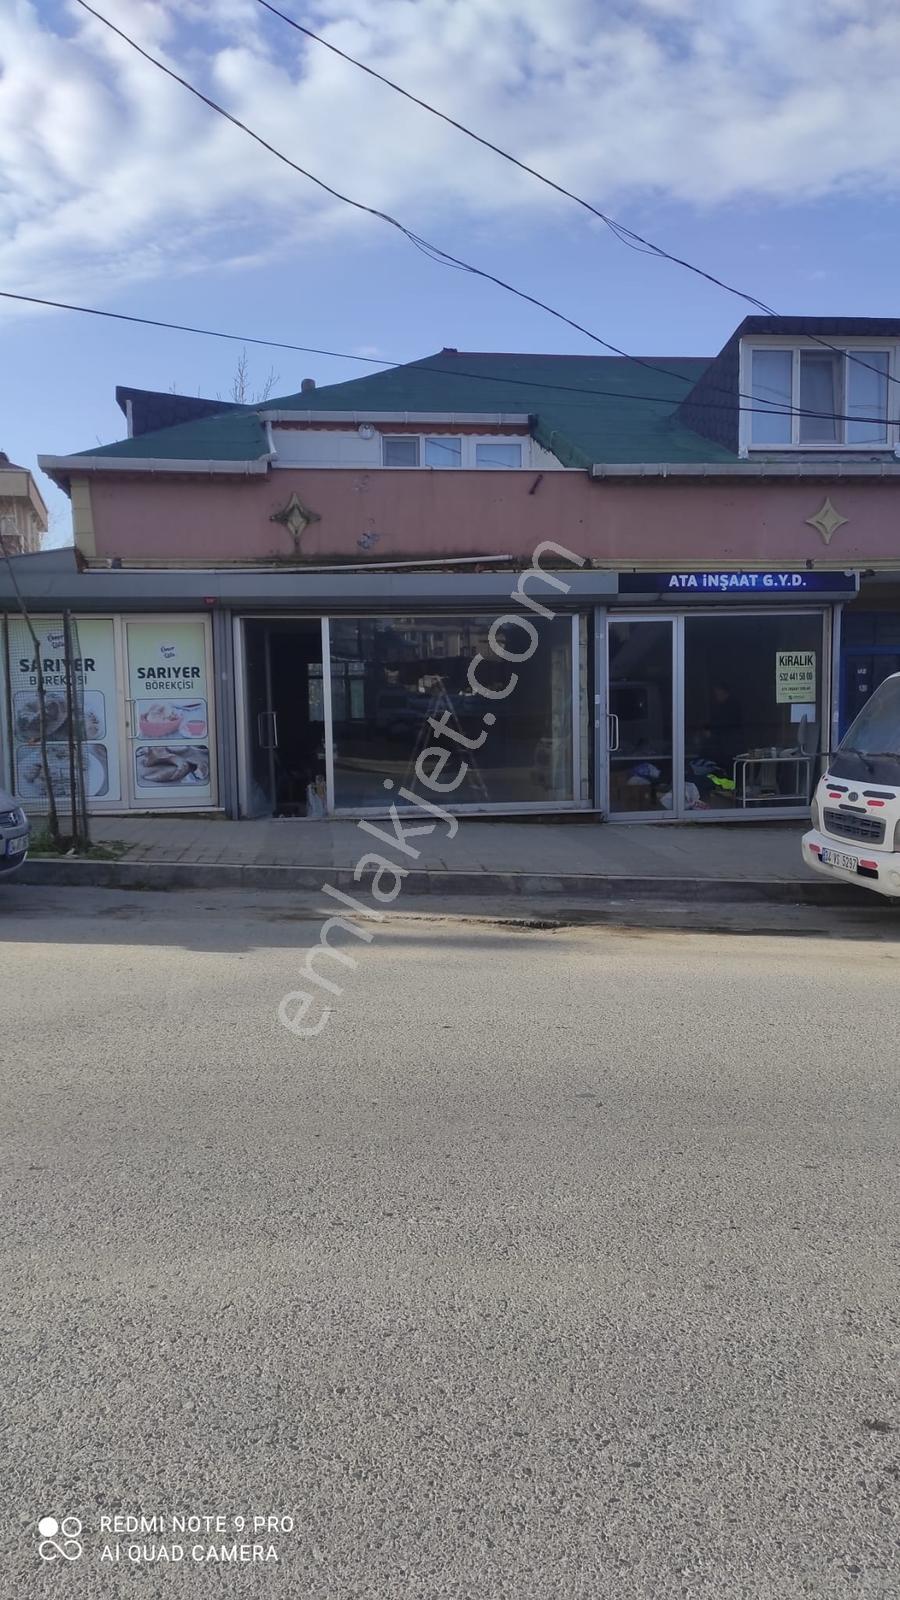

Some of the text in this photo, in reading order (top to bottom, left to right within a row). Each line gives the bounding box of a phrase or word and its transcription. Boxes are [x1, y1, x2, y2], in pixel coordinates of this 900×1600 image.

[669, 574, 698, 587] ATA
[763, 574, 807, 587] G.Y.D.
[137, 666, 200, 679] SARIYER
[145, 680, 194, 691] BÖREKÇİSİ
